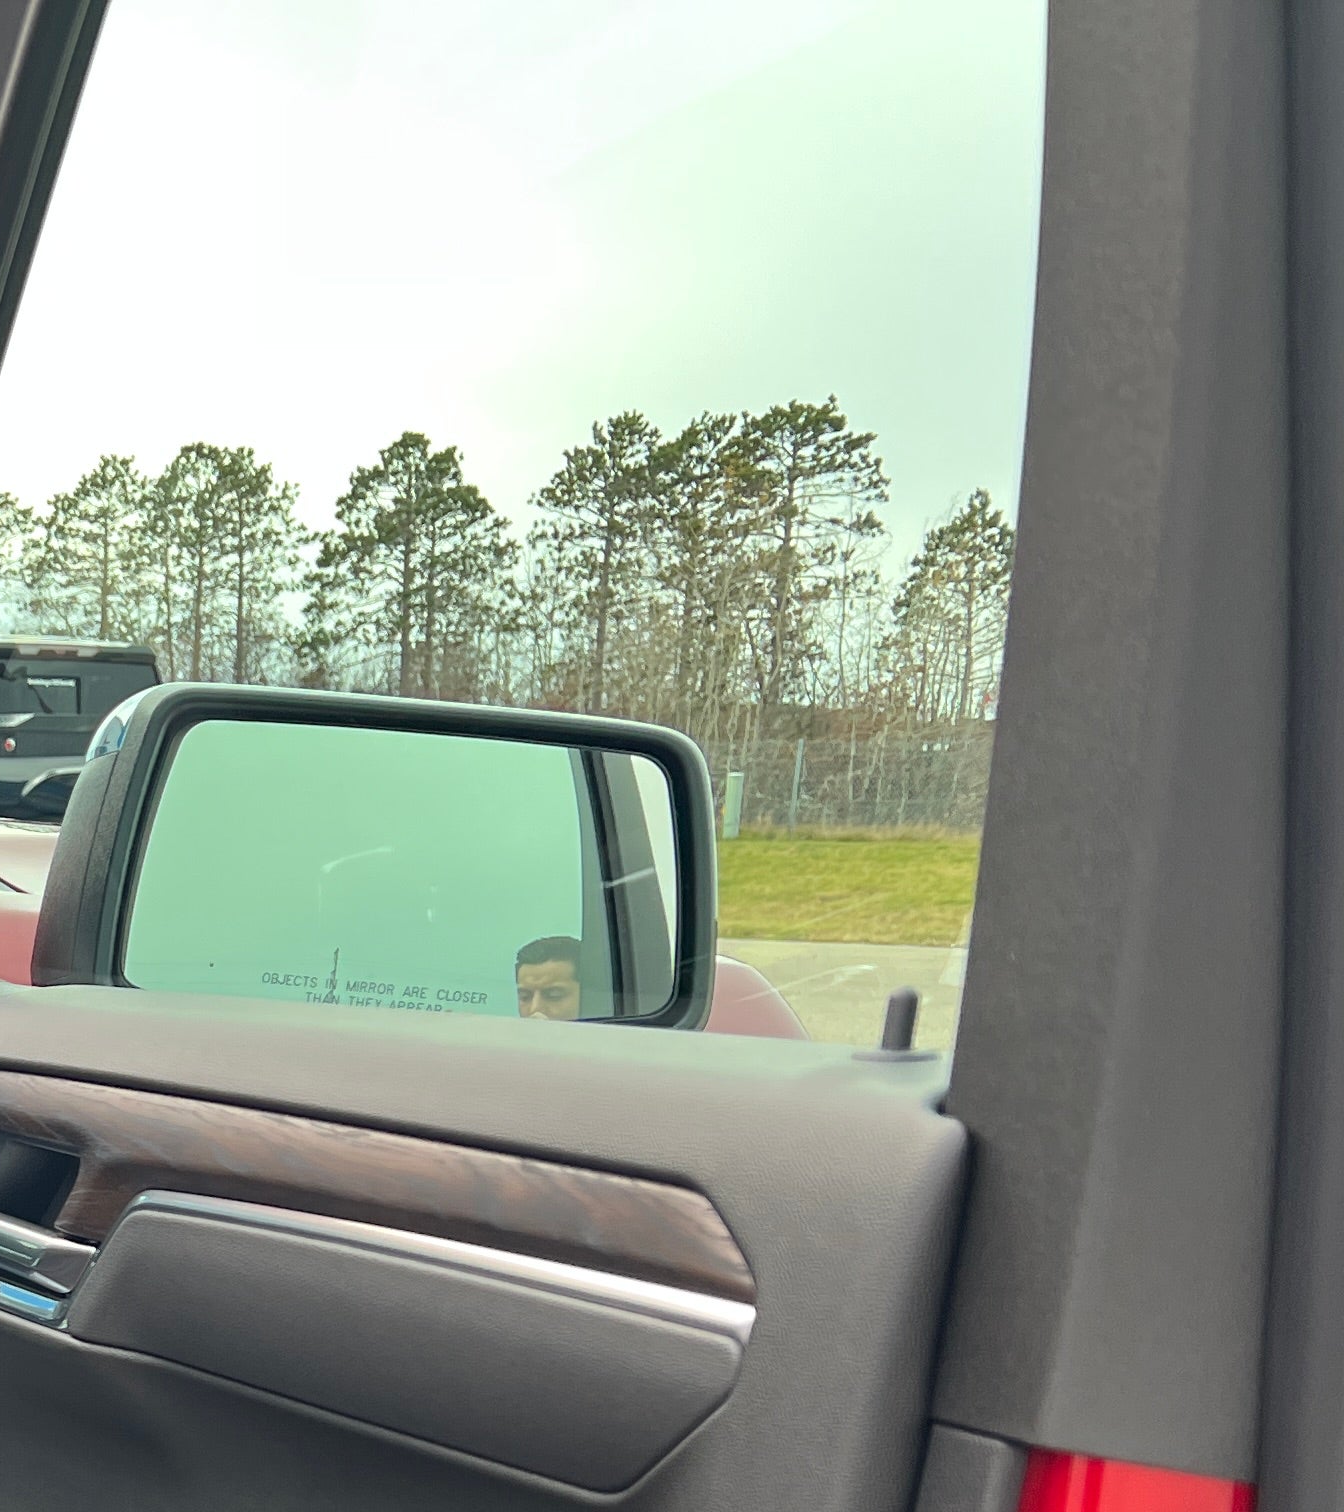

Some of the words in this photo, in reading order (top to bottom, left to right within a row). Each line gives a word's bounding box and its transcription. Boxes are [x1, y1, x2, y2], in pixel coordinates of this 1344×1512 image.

[262, 972, 318, 988] OBJECTS
[325, 978, 337, 990] IN
[345, 979, 395, 995] MIRROR
[402, 985, 429, 999] ARE
[436, 988, 488, 1004] CLOSER
[306, 991, 340, 1005] THAN
